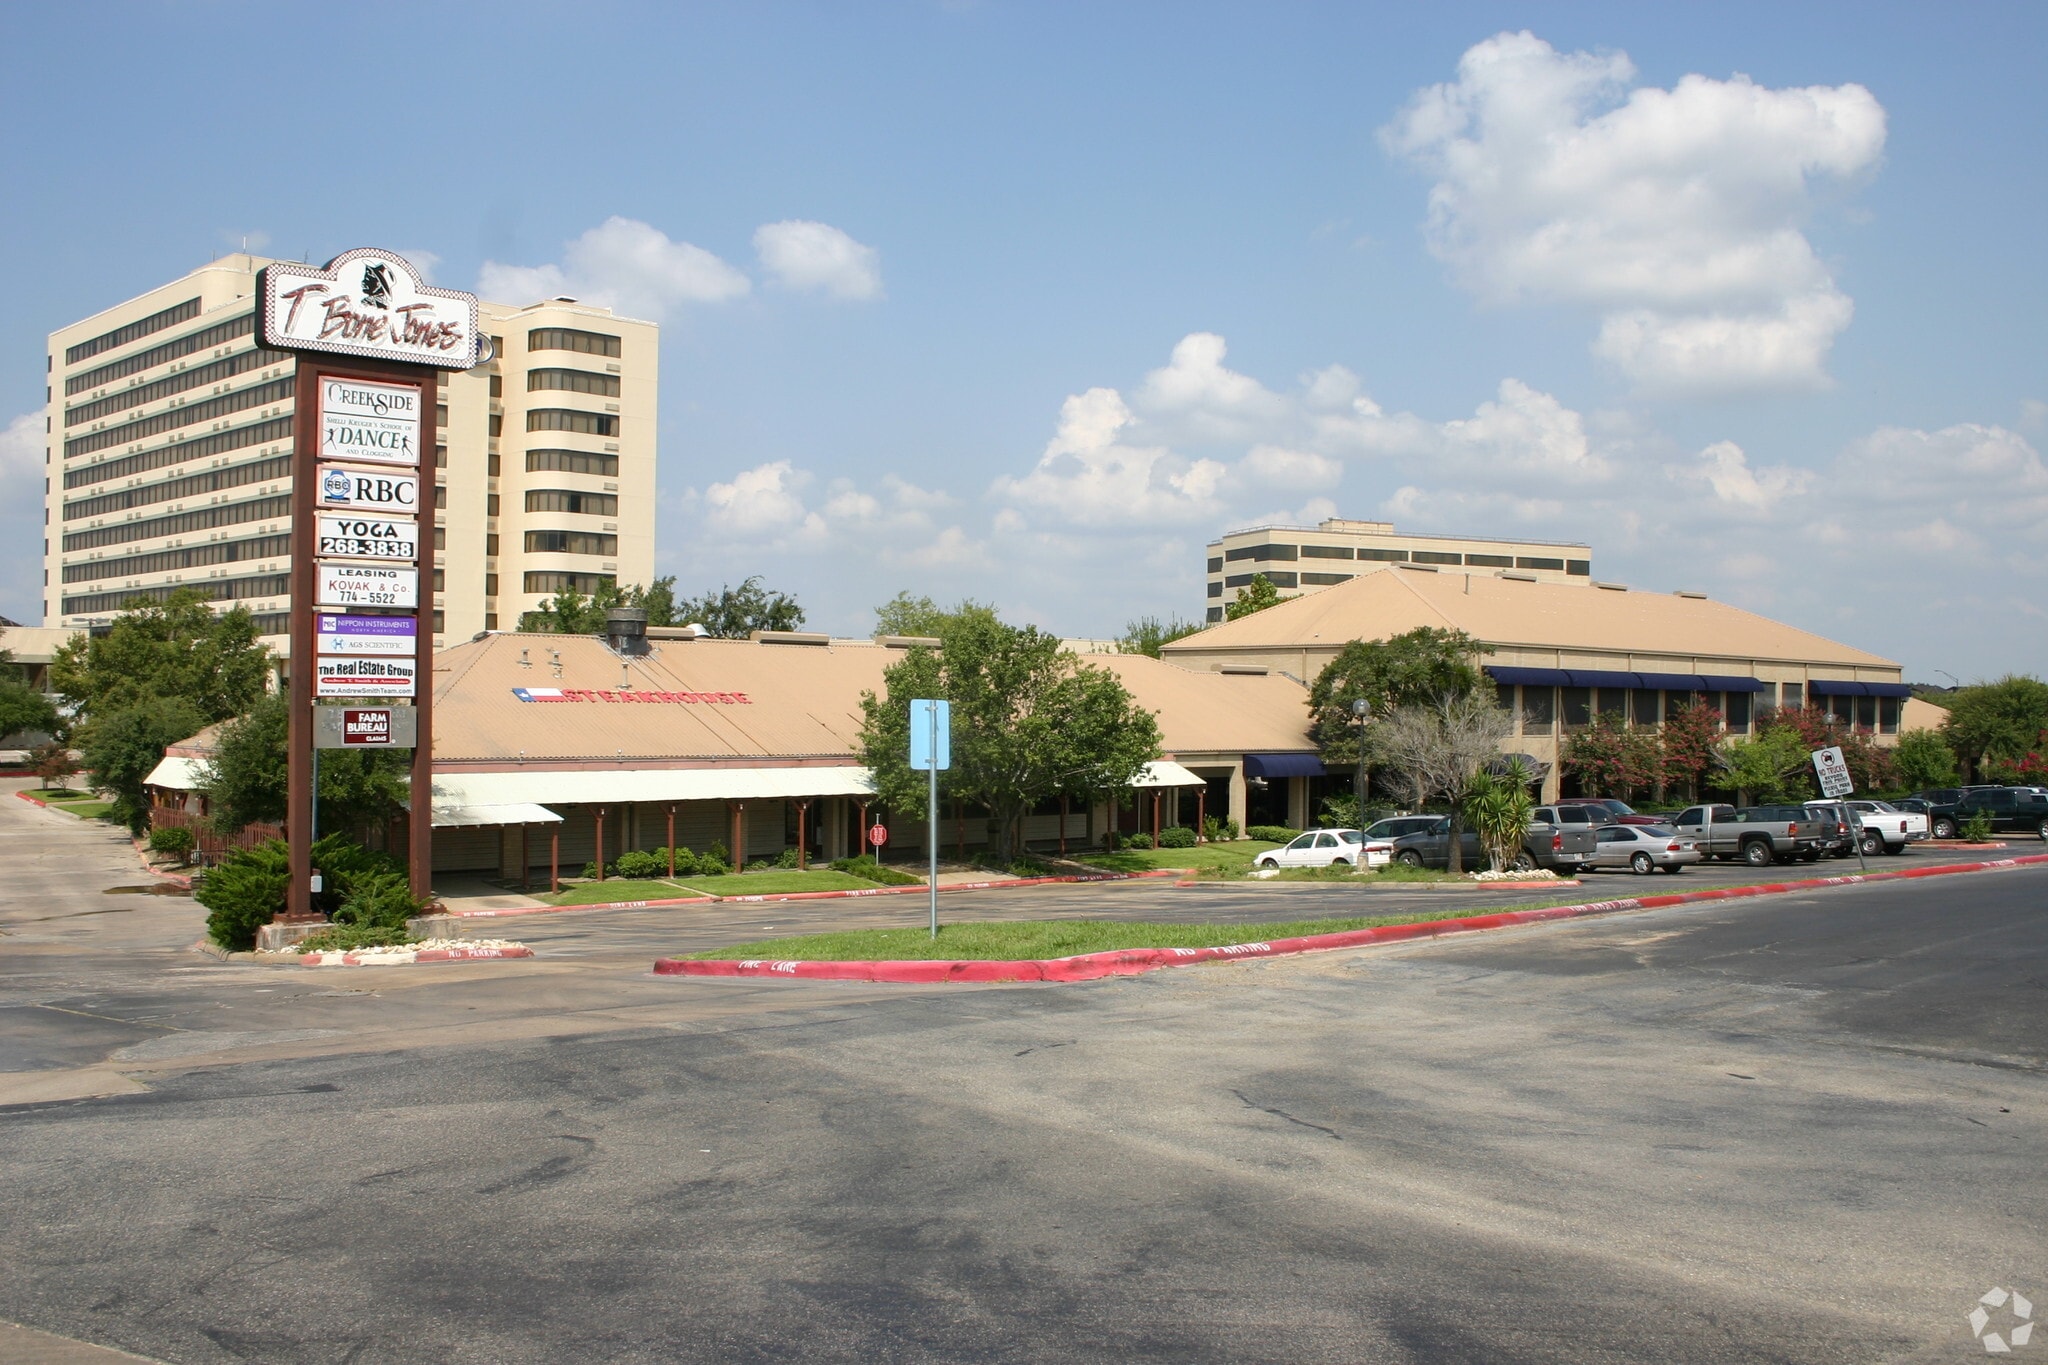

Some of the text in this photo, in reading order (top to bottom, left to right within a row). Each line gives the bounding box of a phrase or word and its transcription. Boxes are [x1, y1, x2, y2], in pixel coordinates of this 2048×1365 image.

[280, 283, 464, 352] T Bone Jones
[328, 382, 414, 416] CREEKSIDE
[380, 422, 402, 431] SCHOOL
[338, 426, 401, 450] DANCE
[327, 480, 349, 490] RBC
[355, 477, 414, 505] RBC
[338, 520, 398, 538] YOGA
[322, 538, 412, 557] 268-3838
[338, 569, 397, 578] LEASING
[328, 580, 370, 591] KOVAK
[379, 583, 386, 592] &
[338, 619, 410, 629] NIPPON INSTRUMENTS
[364, 641, 403, 649] SCIENTIFIC
[336, 661, 357, 675] Real
[358, 660, 385, 676] Estate
[387, 664, 413, 677] Group
[319, 687, 412, 695] www.AndrewSmithTeam.com
[560, 688, 753, 705] STEAKHOUSE
[358, 712, 387, 722] FARM
[347, 722, 388, 732] BUREAU
[448, 948, 503, 958] NO PARKING
